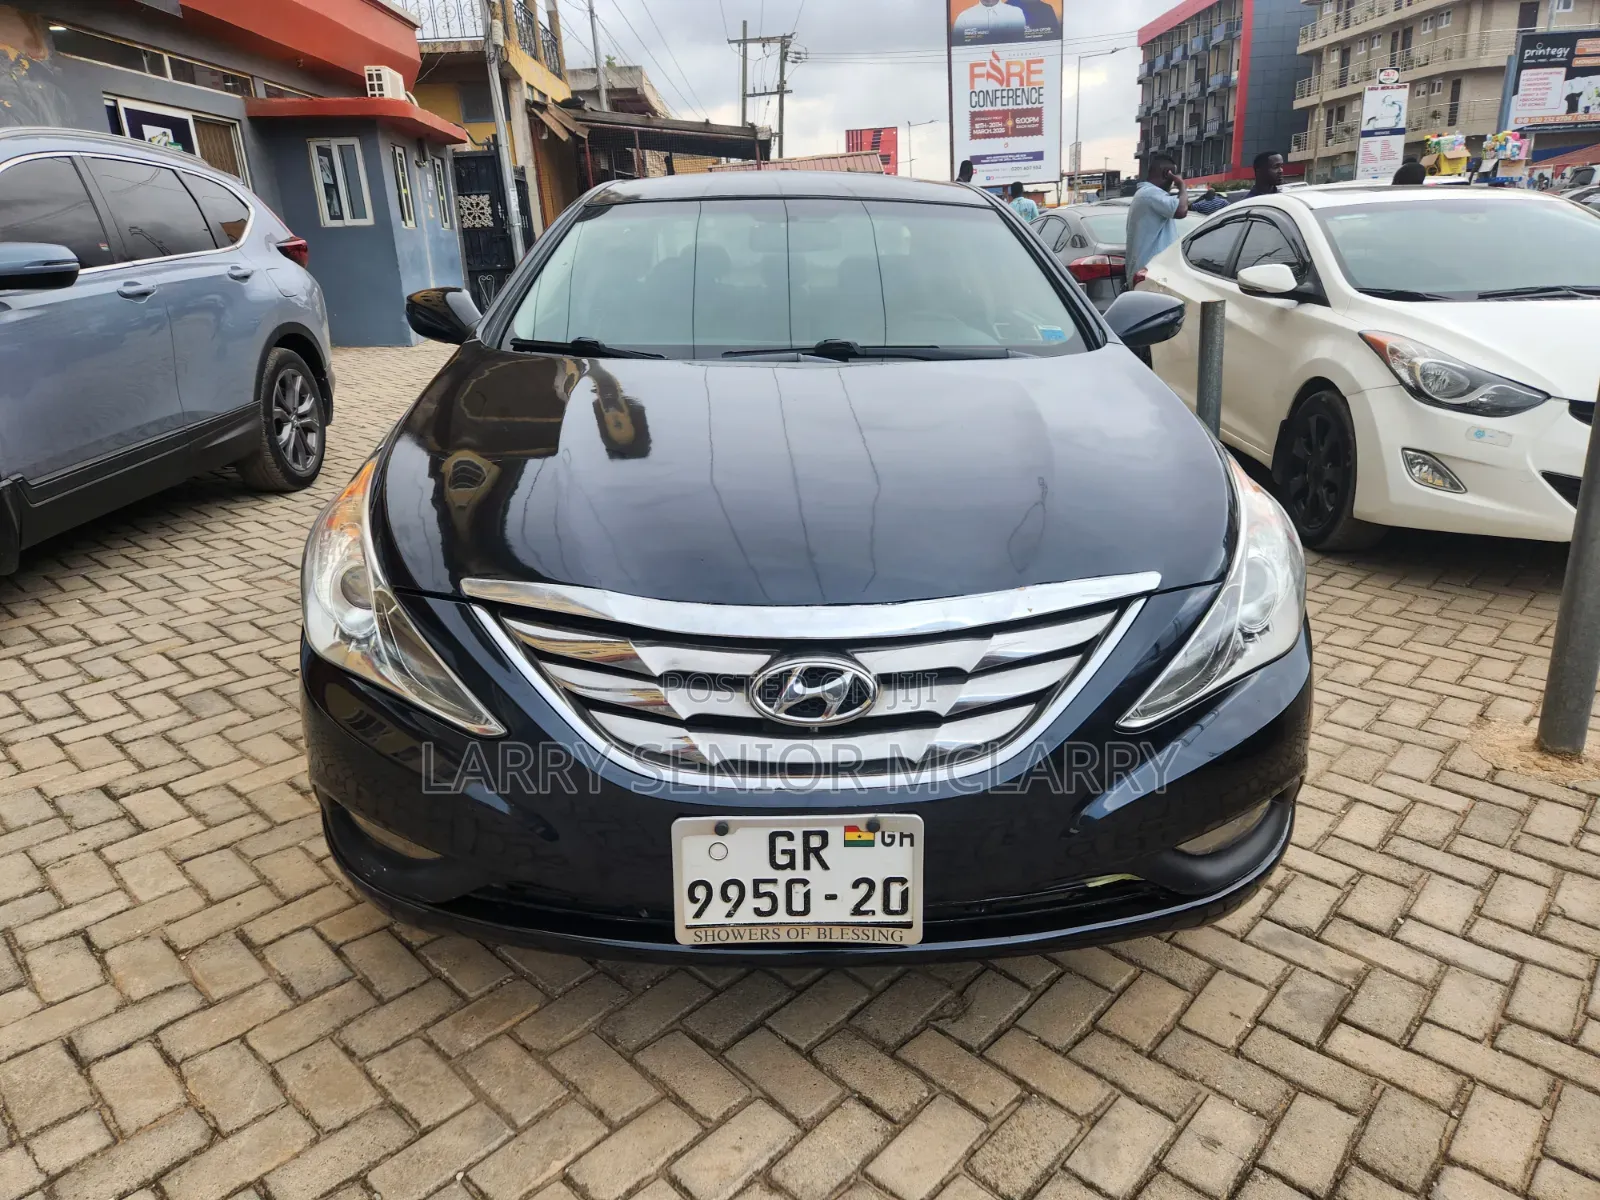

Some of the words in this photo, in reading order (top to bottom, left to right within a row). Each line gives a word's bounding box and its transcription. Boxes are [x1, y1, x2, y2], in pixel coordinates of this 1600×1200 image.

[1523, 44, 1570, 59] printegy
[969, 86, 1044, 109] CONFERENCE
[881, 831, 914, 847] GH
[768, 830, 830, 871] GR
[693, 927, 781, 943] SHOWERS
[786, 927, 811, 942] OF
[816, 927, 904, 943] BLESSING
